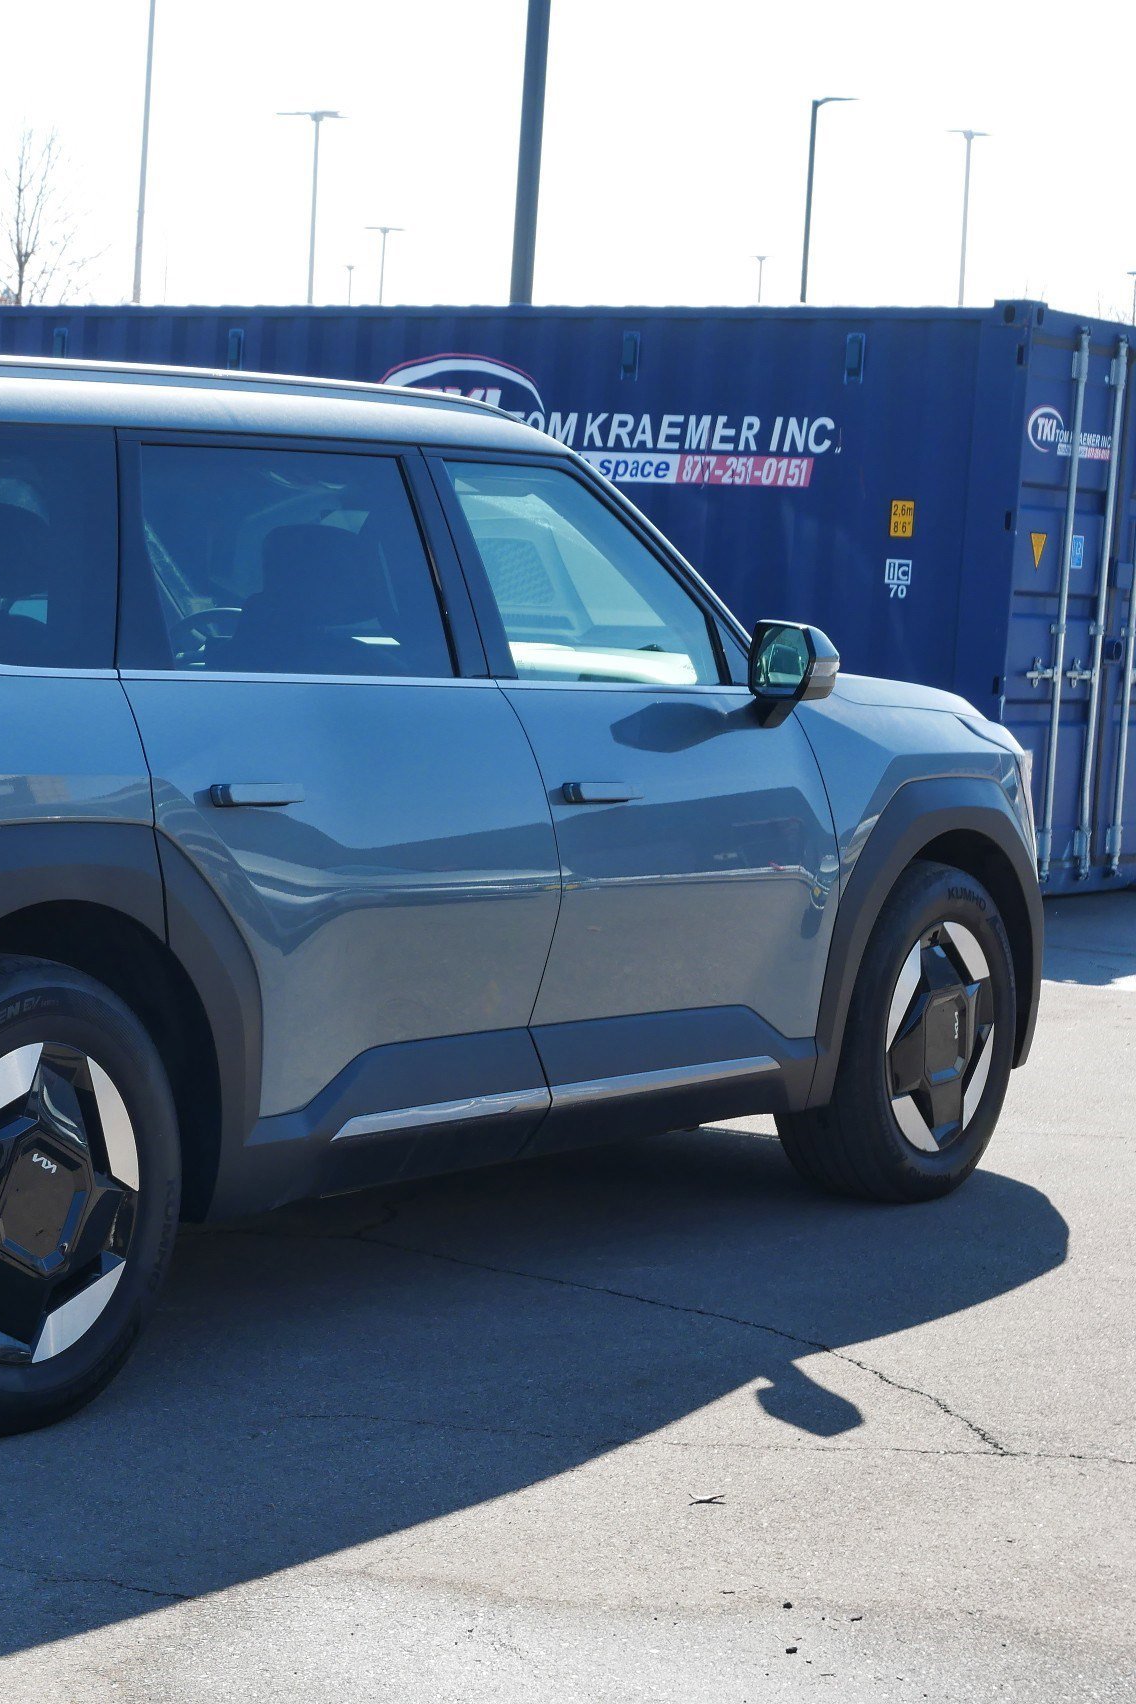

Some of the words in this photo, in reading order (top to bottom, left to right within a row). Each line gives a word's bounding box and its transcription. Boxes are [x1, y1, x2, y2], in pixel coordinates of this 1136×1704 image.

[583, 412, 761, 452] KRAEMER
[1037, 417, 1057, 442] TKI
[598, 457, 671, 480] space
[682, 455, 810, 487] 877-251-0151
[889, 584, 907, 599] 70
[948, 886, 987, 911] KUMHO
